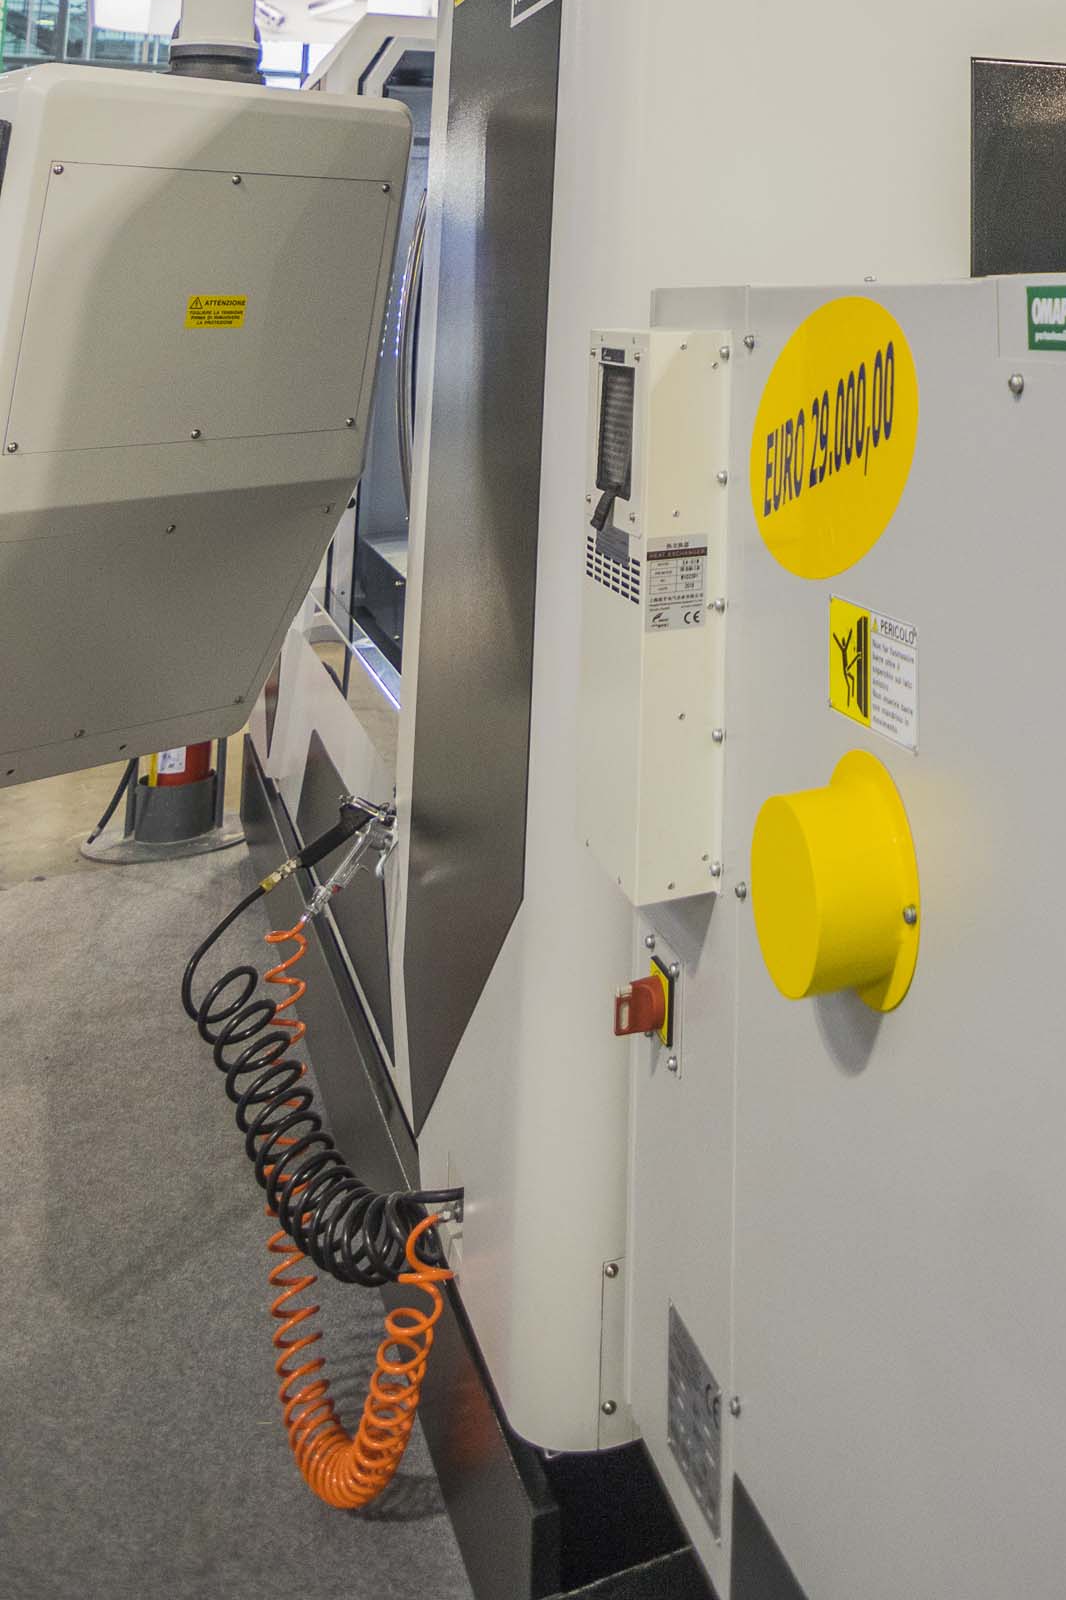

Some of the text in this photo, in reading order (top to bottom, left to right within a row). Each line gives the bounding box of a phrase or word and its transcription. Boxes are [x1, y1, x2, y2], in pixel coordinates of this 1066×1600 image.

[763, 341, 894, 517] EURO 29.000,00
[880, 619, 915, 645] PERICOLO
